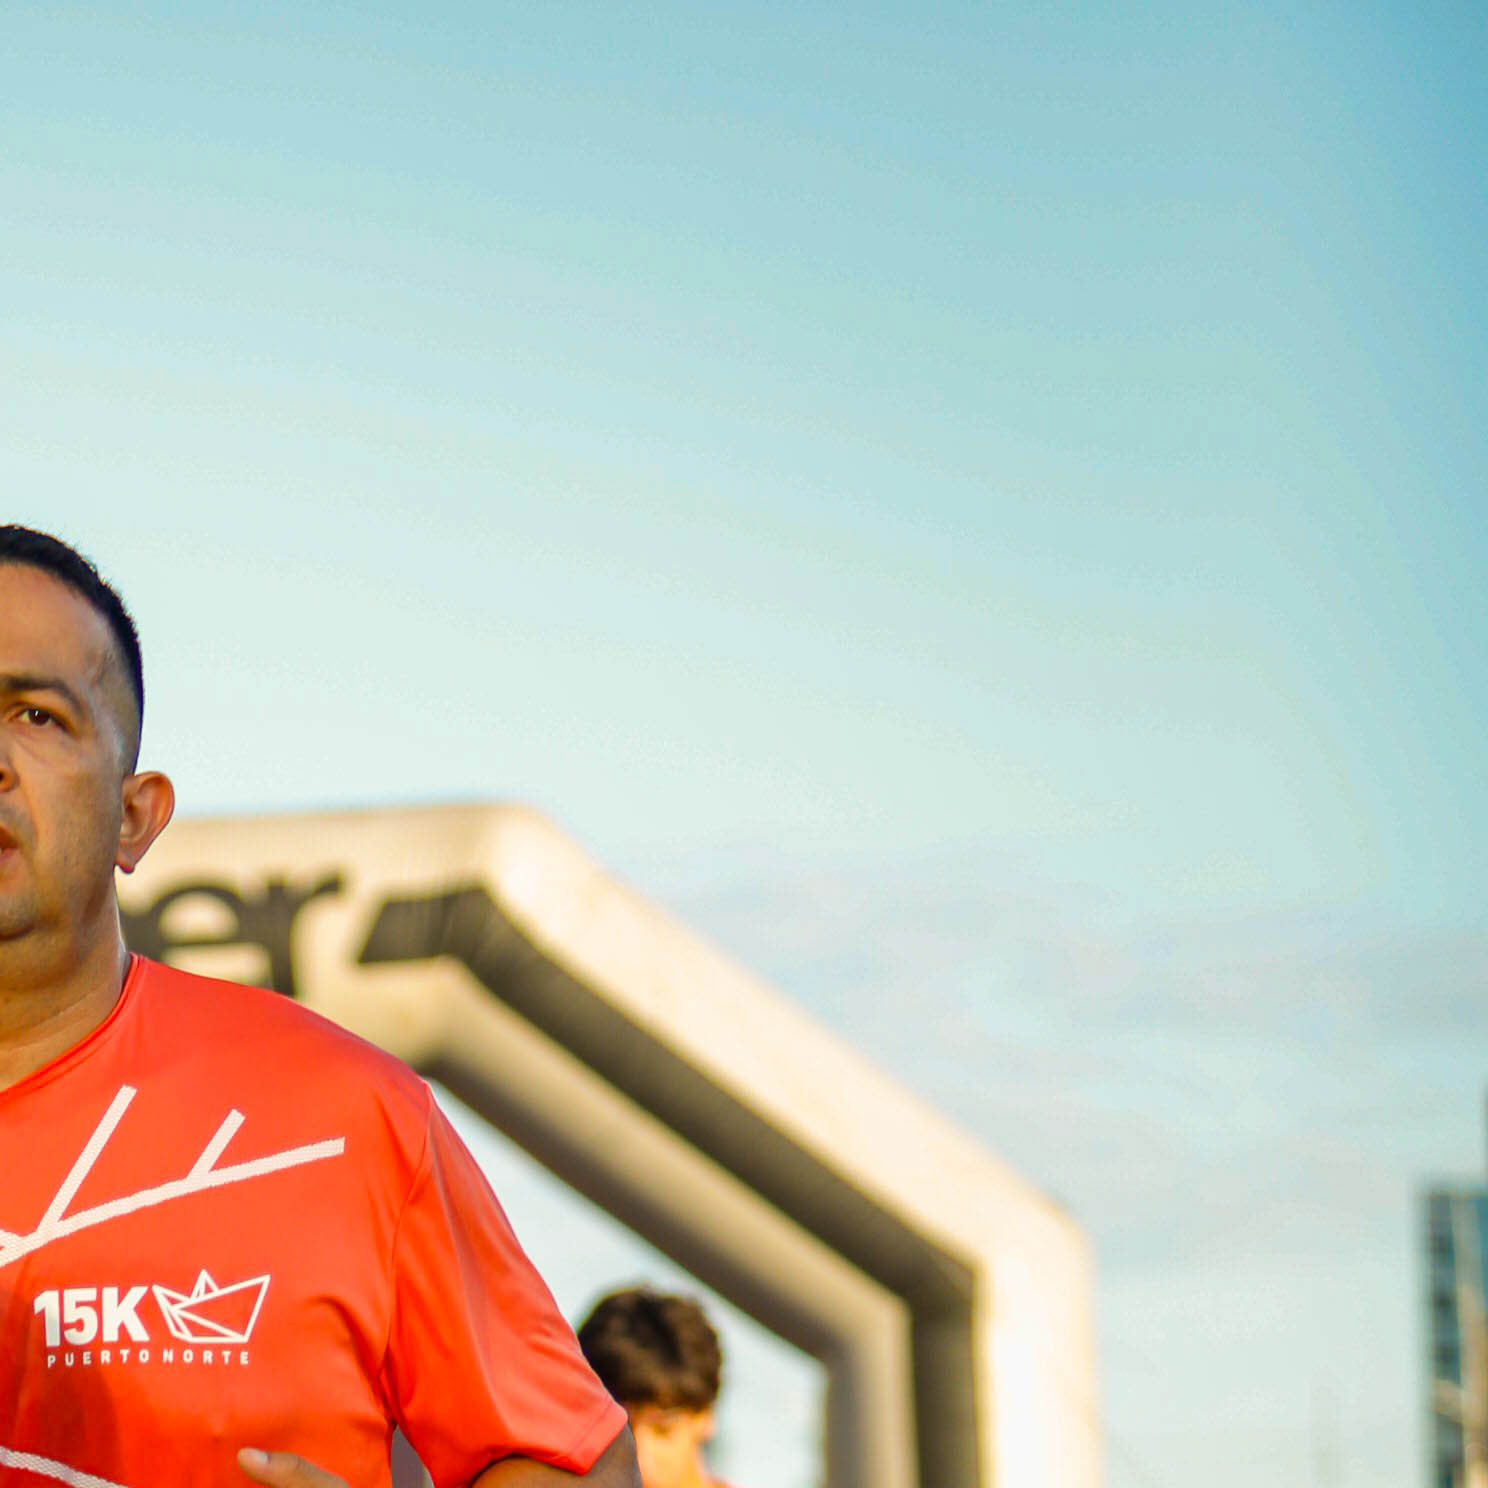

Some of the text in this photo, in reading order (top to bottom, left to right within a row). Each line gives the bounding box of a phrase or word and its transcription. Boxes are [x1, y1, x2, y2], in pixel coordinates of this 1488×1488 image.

[33, 1286, 150, 1348] 15K
[46, 1348, 250, 1368] PUERTO NORTE
